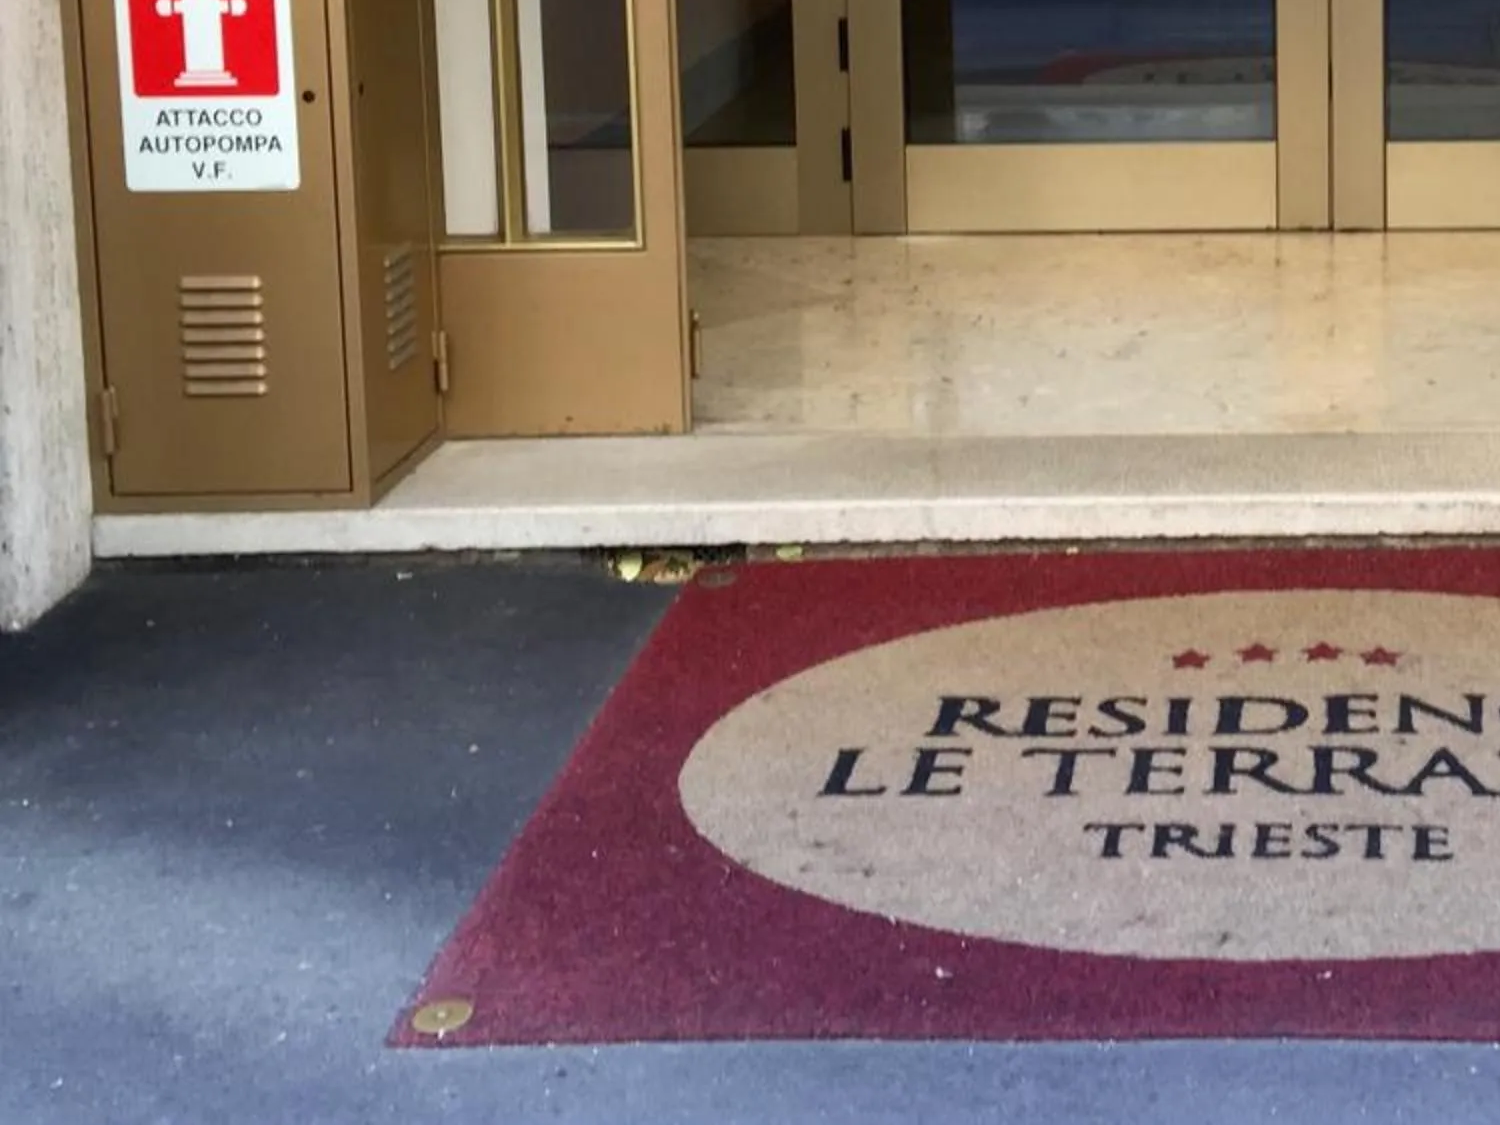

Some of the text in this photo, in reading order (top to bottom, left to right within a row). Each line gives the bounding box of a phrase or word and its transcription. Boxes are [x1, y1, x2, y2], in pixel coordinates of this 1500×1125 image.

[156, 108, 263, 127] ATTACCO
[139, 134, 283, 154] AUTOPOMPA
[191, 160, 233, 180] V.F.
[815, 745, 975, 798] LE
[1082, 821, 1456, 861] TRIESTE
